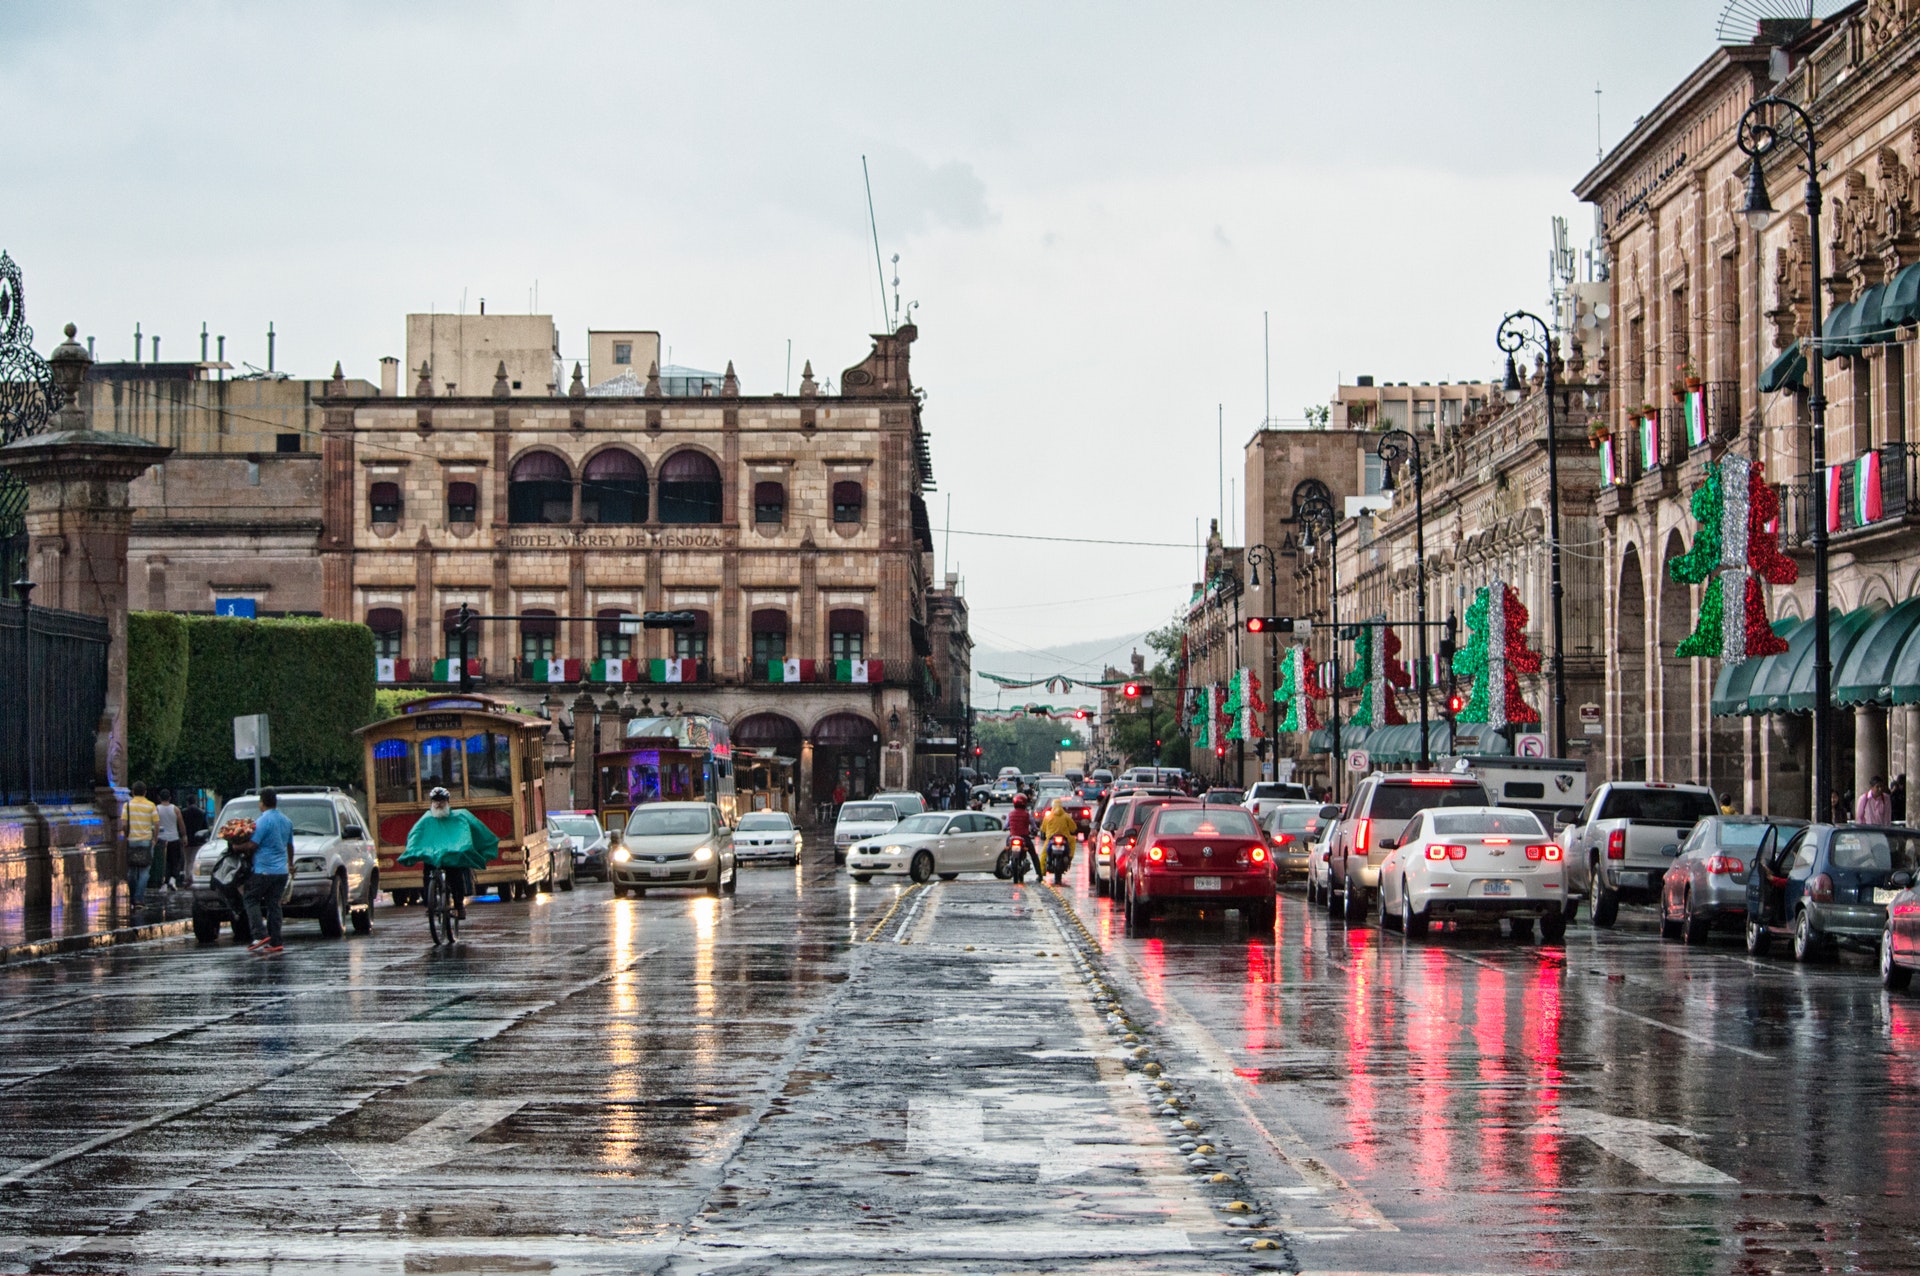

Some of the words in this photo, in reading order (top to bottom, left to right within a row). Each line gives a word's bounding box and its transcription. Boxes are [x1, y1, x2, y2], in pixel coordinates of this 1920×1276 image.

[510, 535, 557, 547] HOTEL
[560, 535, 619, 547] VIRREY
[626, 535, 646, 547] DE
